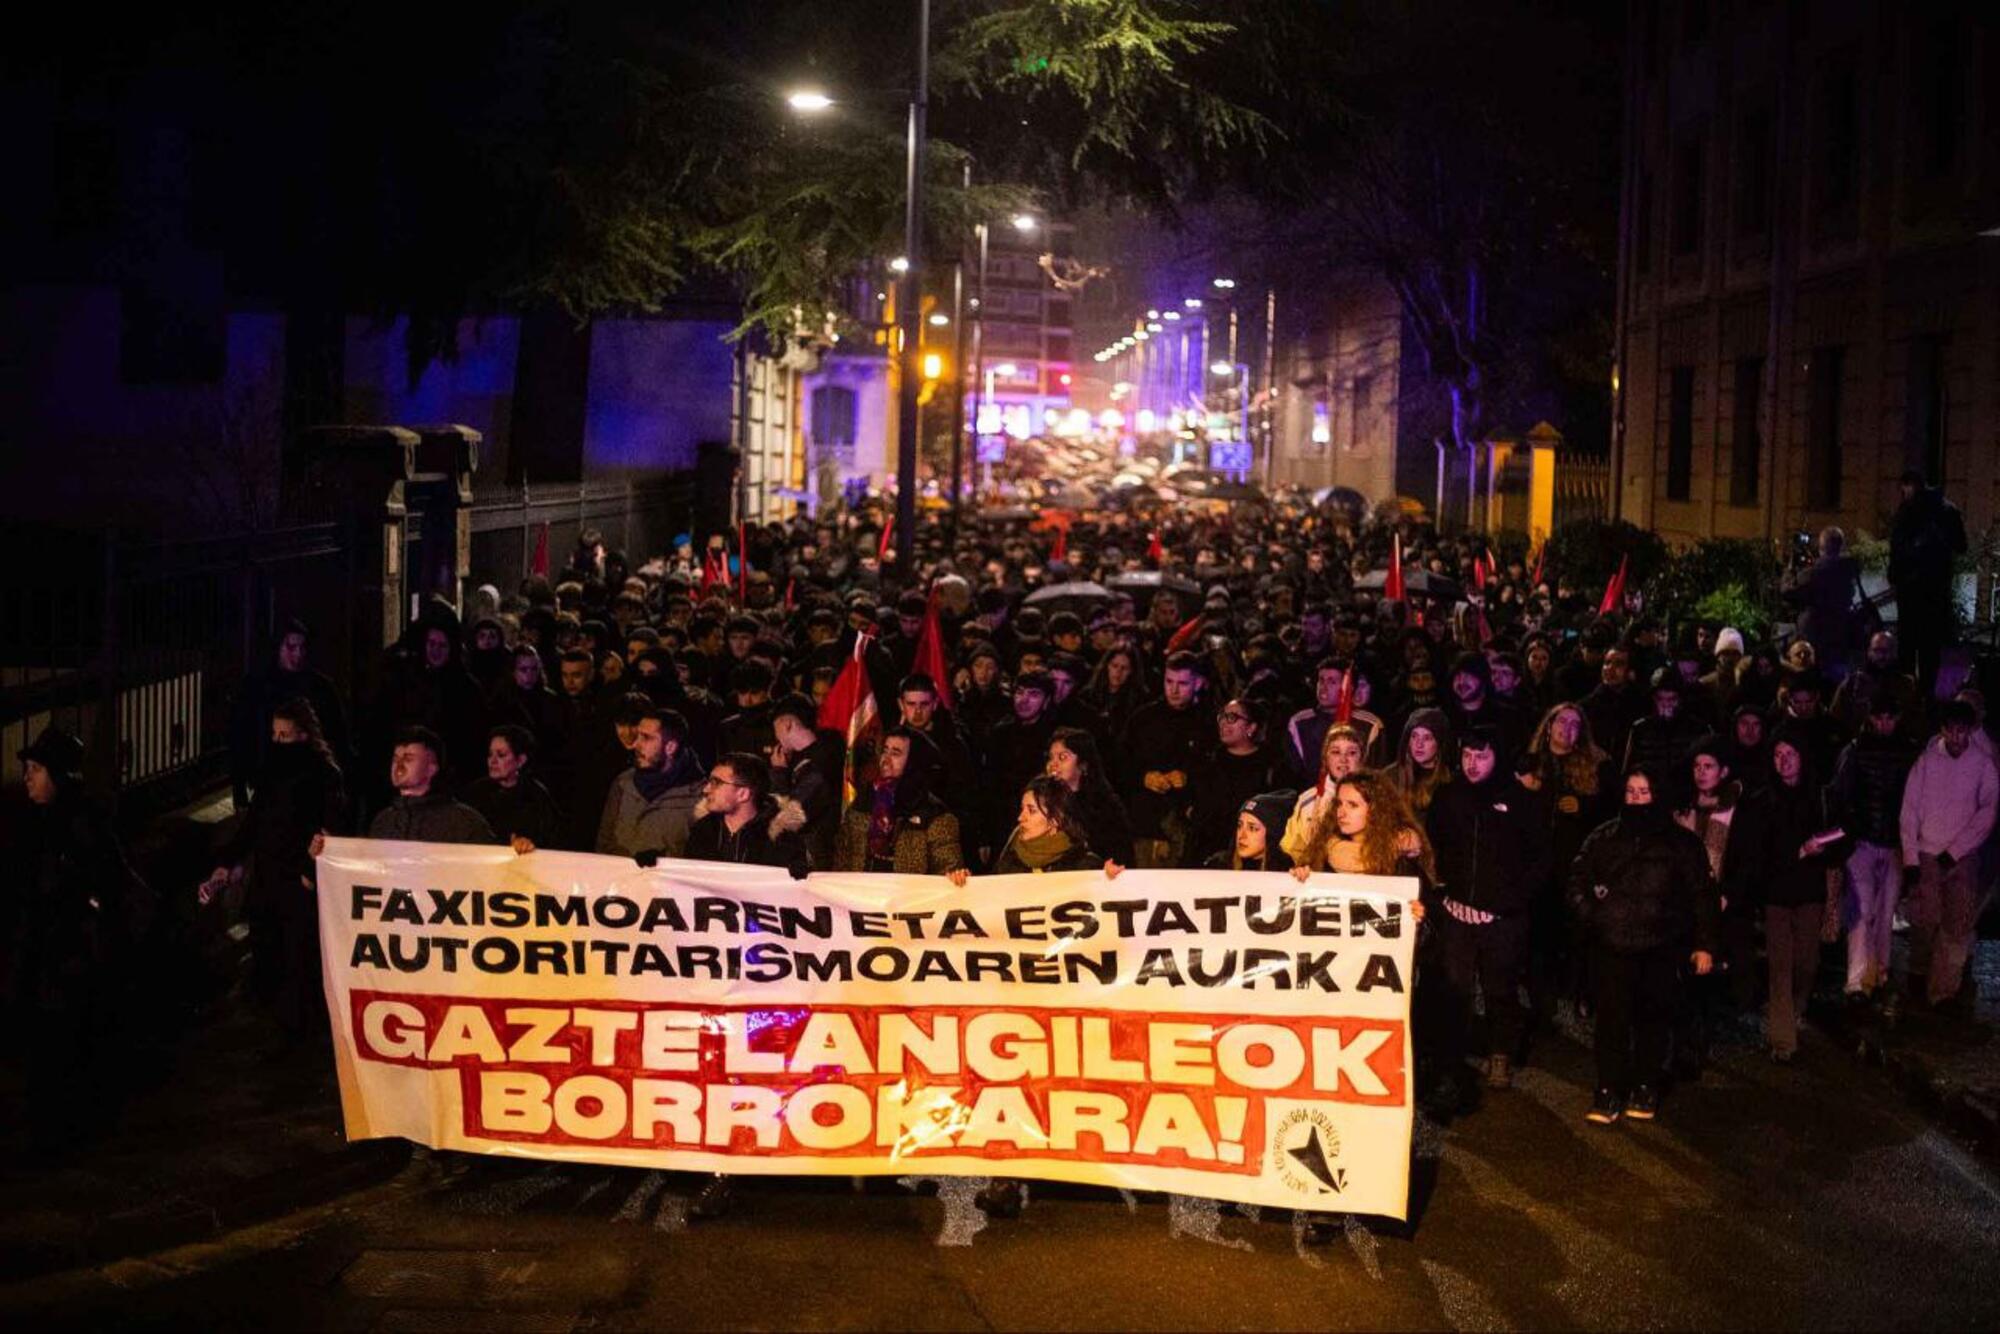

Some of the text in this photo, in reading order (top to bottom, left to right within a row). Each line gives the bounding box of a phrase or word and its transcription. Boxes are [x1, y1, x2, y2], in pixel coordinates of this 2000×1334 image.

[350, 885, 1402, 940] FAXISMOAREN ETA ESTATUEN
[350, 933, 1119, 986] AUTORITARISMOAREN
[479, 1070, 1249, 1166] BORROKARA!
